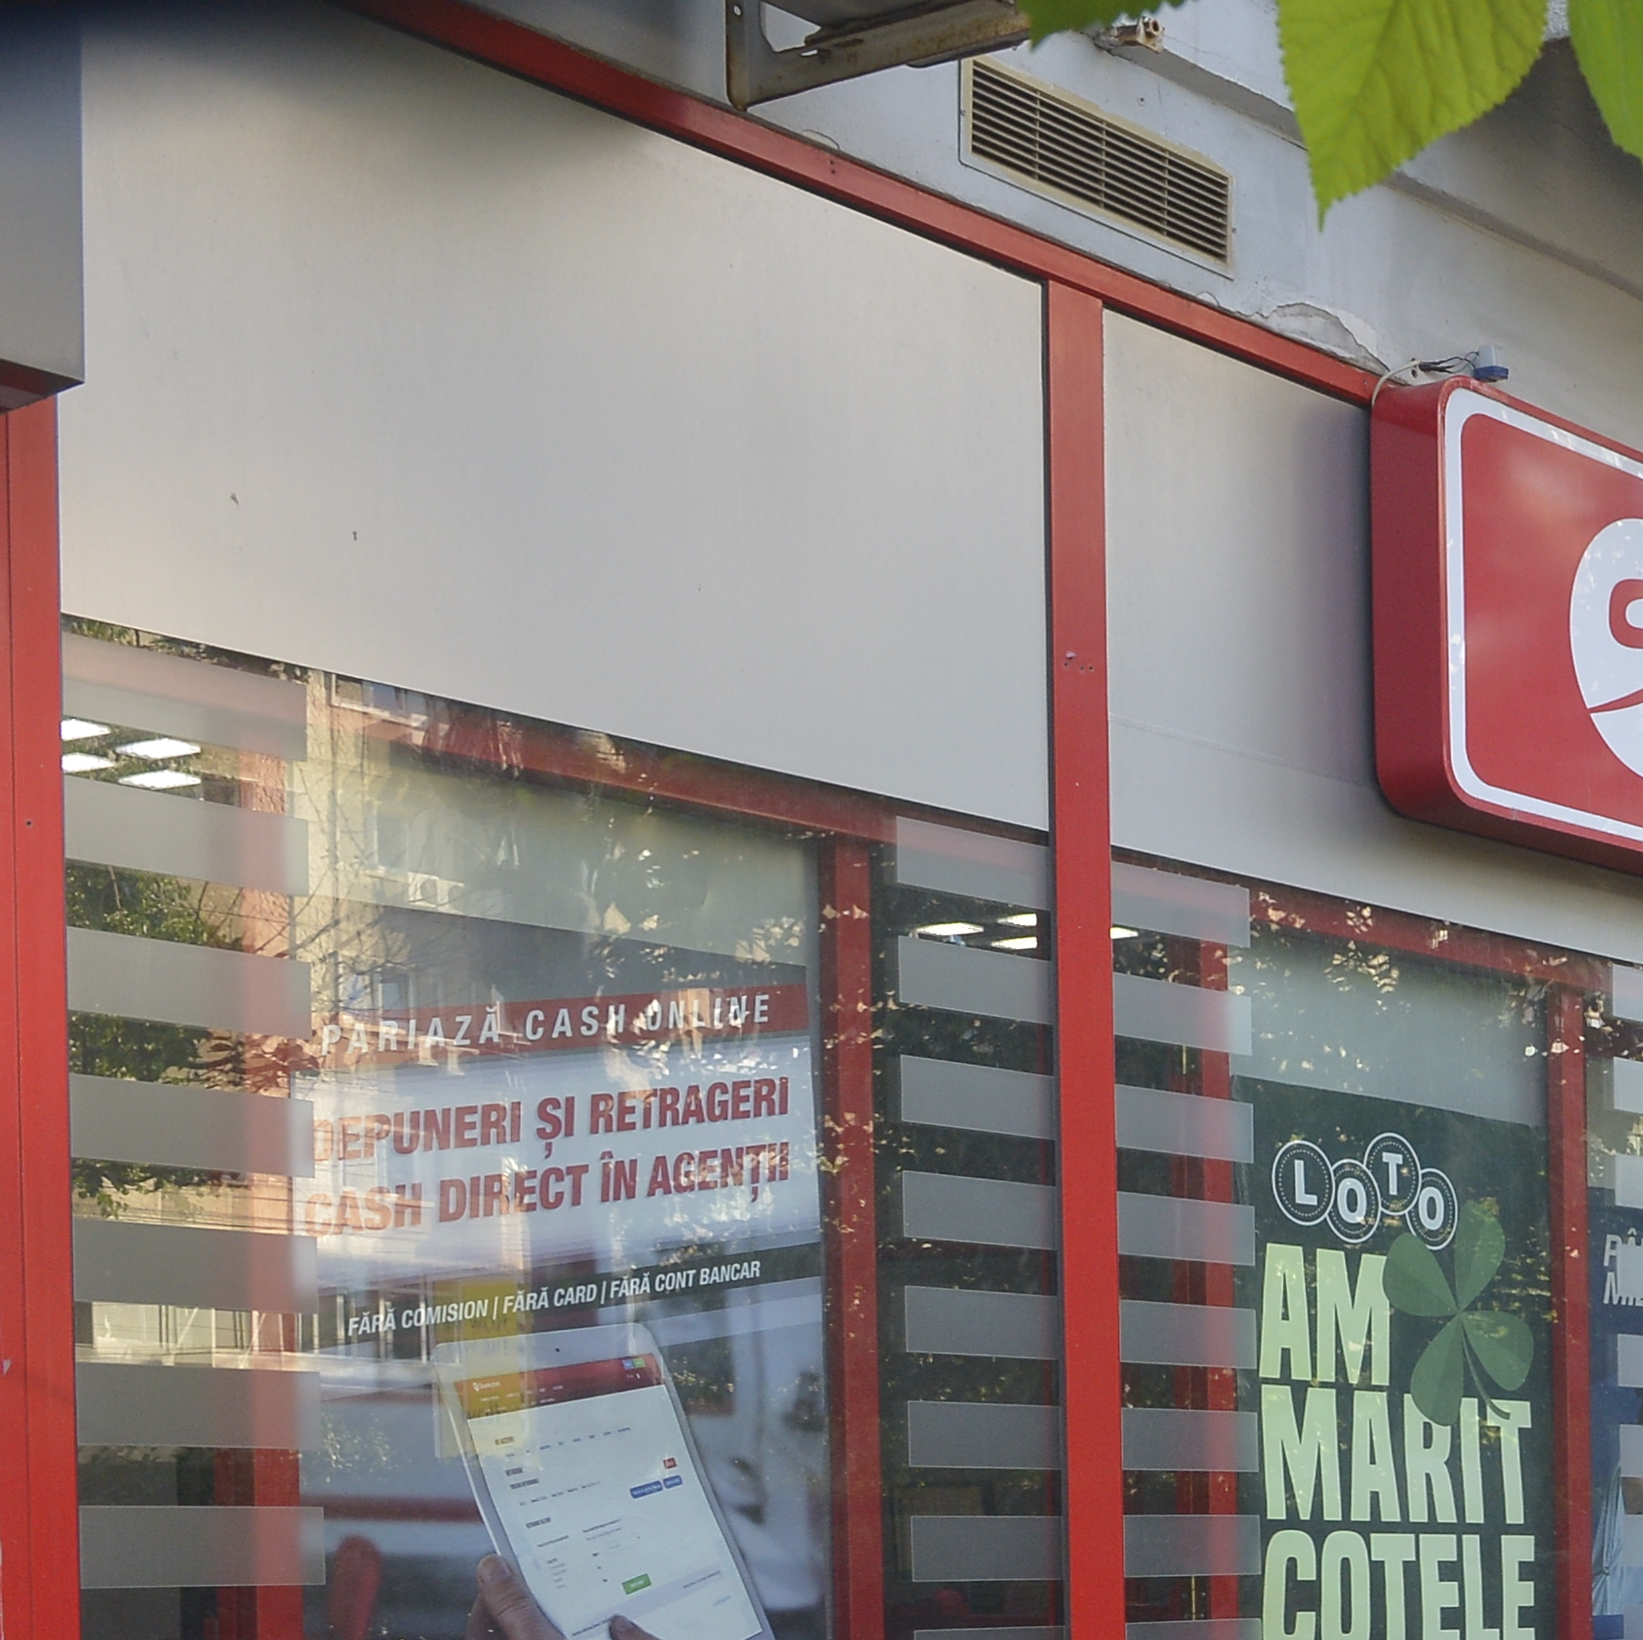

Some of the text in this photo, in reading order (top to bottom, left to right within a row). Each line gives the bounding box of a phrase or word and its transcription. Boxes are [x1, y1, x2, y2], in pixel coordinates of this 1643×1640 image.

[525, 1001, 626, 1042] CASH
[645, 994, 771, 1032] ONLINE
[313, 1076, 790, 1163] DEPUNERI ȘI RETRAGERI
[304, 1142, 790, 1237] CASH DIRECT ÎN AGENȚII
[1293, 1152, 1445, 1231] LOTO
[347, 1260, 761, 1338] FĂRĂ COMISION FĂRĂ CARD FĂRĂ CONT BANCAR
[1258, 1242, 1391, 1386] AM
[1260, 1383, 1533, 1525] MARIT
